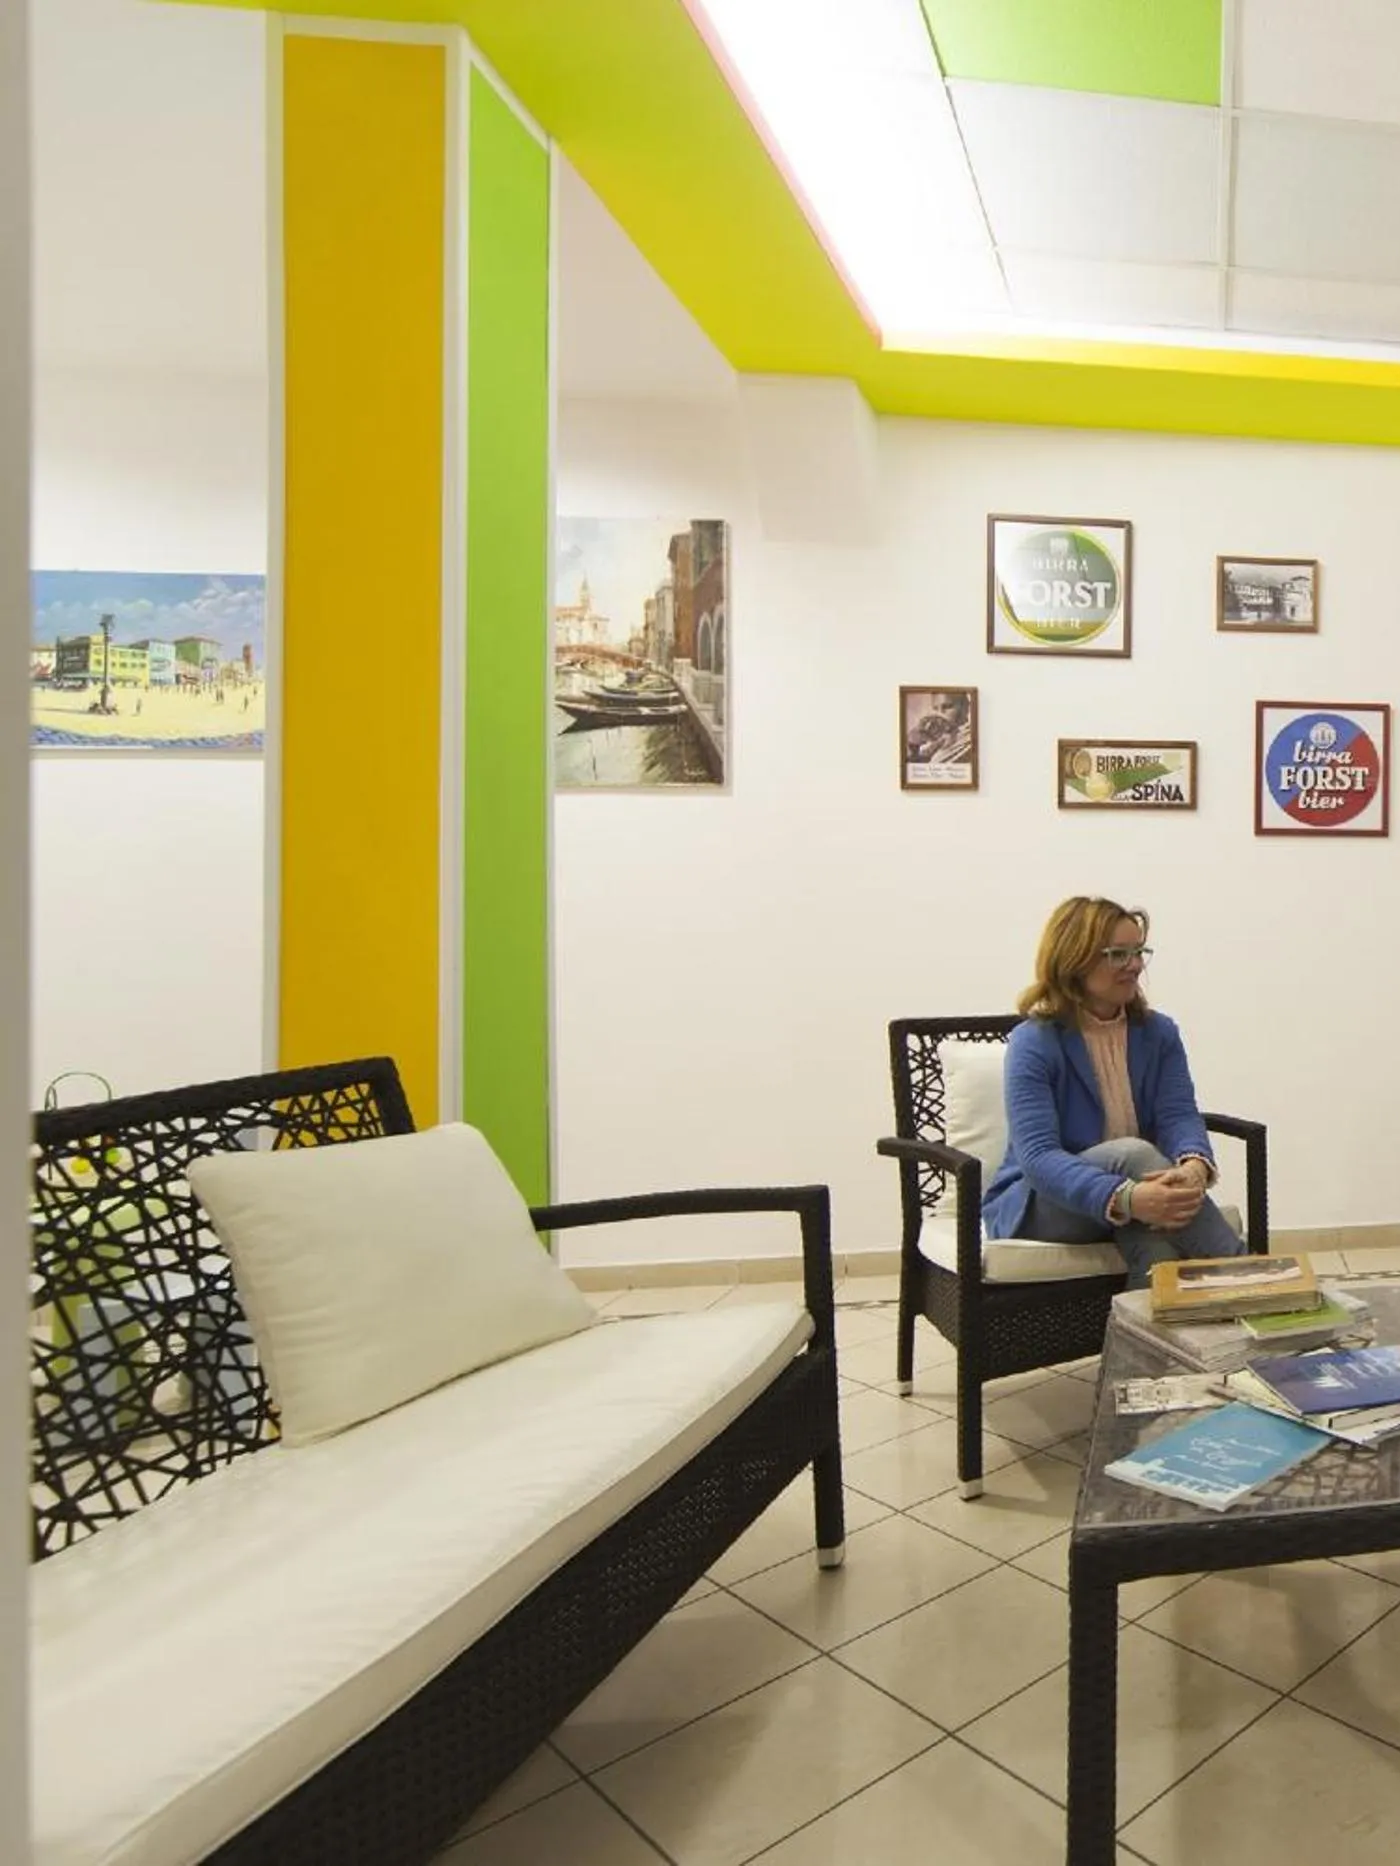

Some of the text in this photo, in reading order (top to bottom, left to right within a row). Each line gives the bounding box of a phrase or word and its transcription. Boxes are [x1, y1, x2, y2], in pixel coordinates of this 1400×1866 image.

[1292, 740, 1355, 764] birra
[1096, 754, 1133, 773] BIRRA
[1279, 765, 1370, 792] FORST
[1297, 790, 1345, 809] bier
